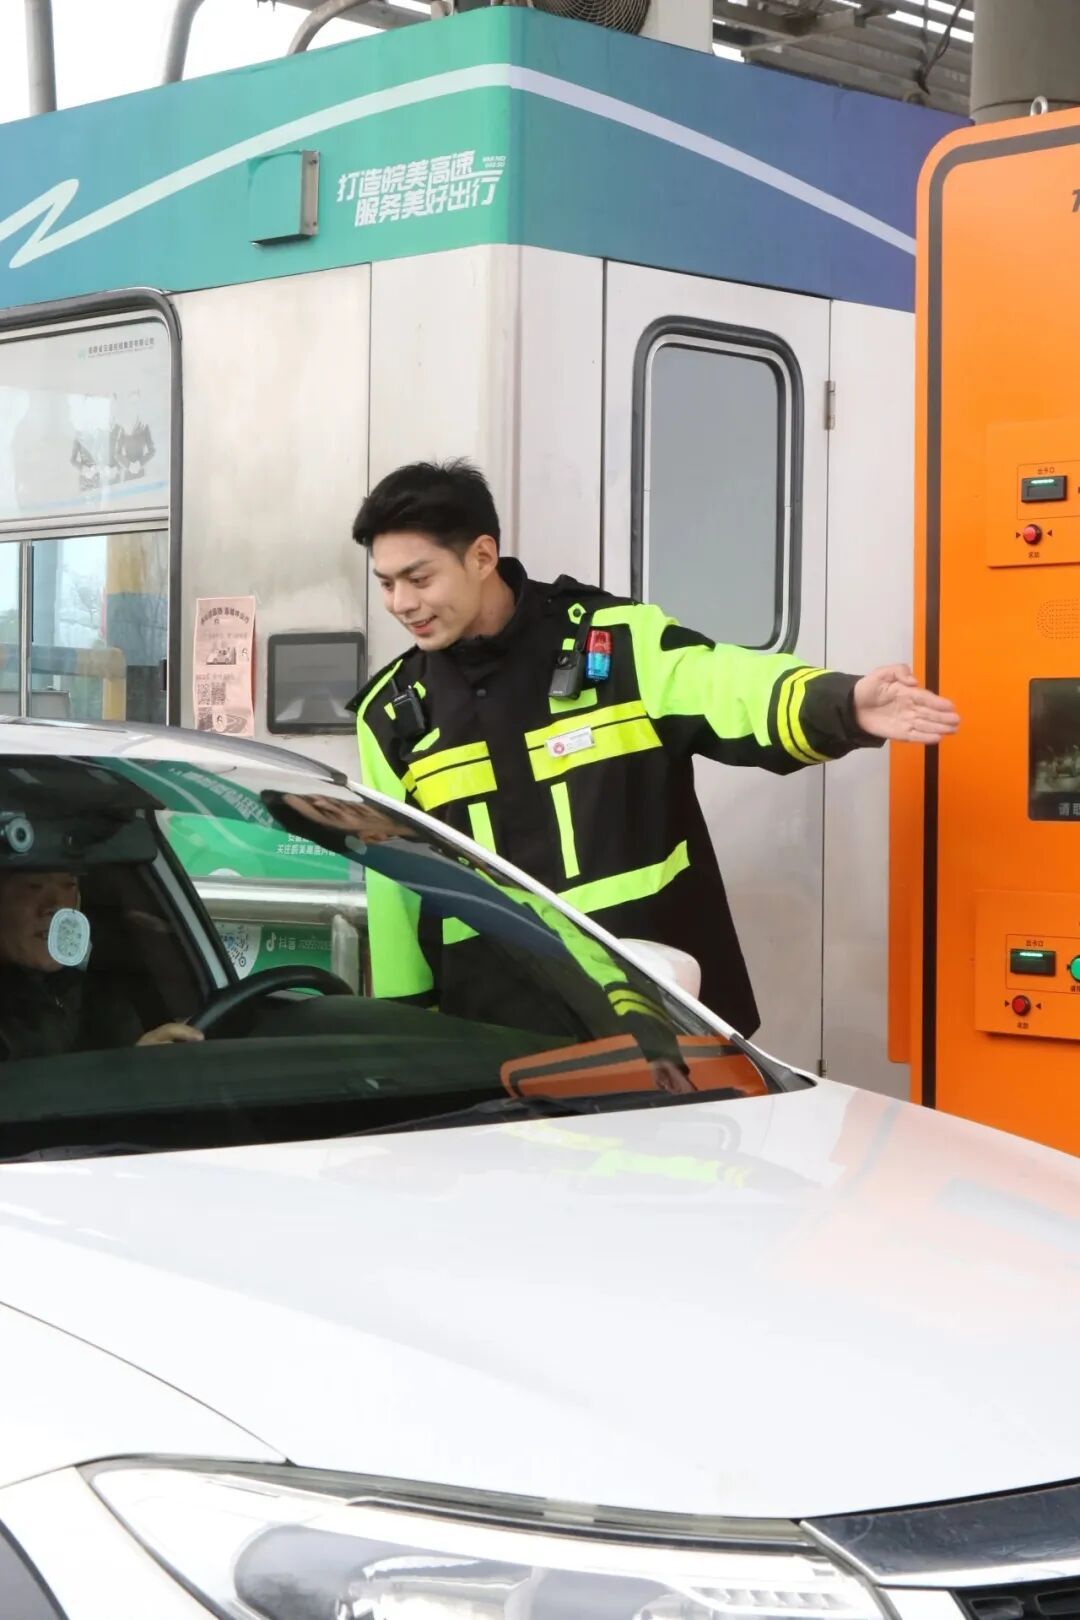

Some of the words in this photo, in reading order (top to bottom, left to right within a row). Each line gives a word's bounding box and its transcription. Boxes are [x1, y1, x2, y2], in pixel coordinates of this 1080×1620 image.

[336, 150, 503, 202] 打造皖美高速
[354, 177, 500, 227] 服务美好出行
[278, 937, 297, 951] 抖音
